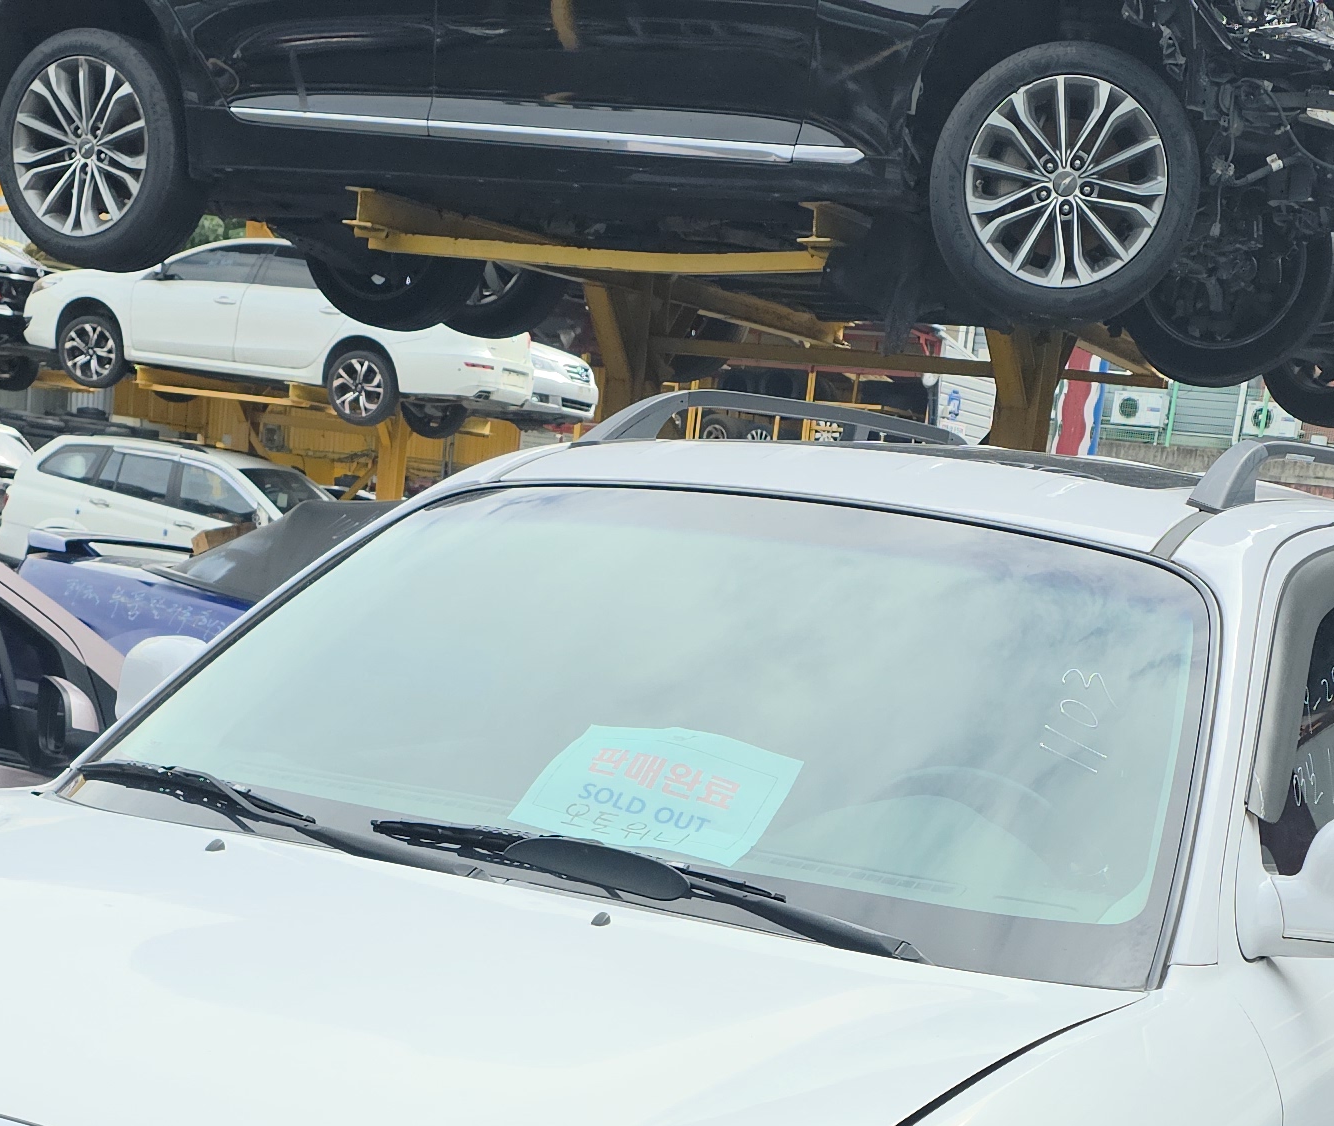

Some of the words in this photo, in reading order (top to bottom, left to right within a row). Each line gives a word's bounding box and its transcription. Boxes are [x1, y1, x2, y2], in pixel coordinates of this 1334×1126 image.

[587, 747, 741, 810] 판매완료
[578, 782, 647, 815] SOLD
[653, 806, 712, 834] OUT
